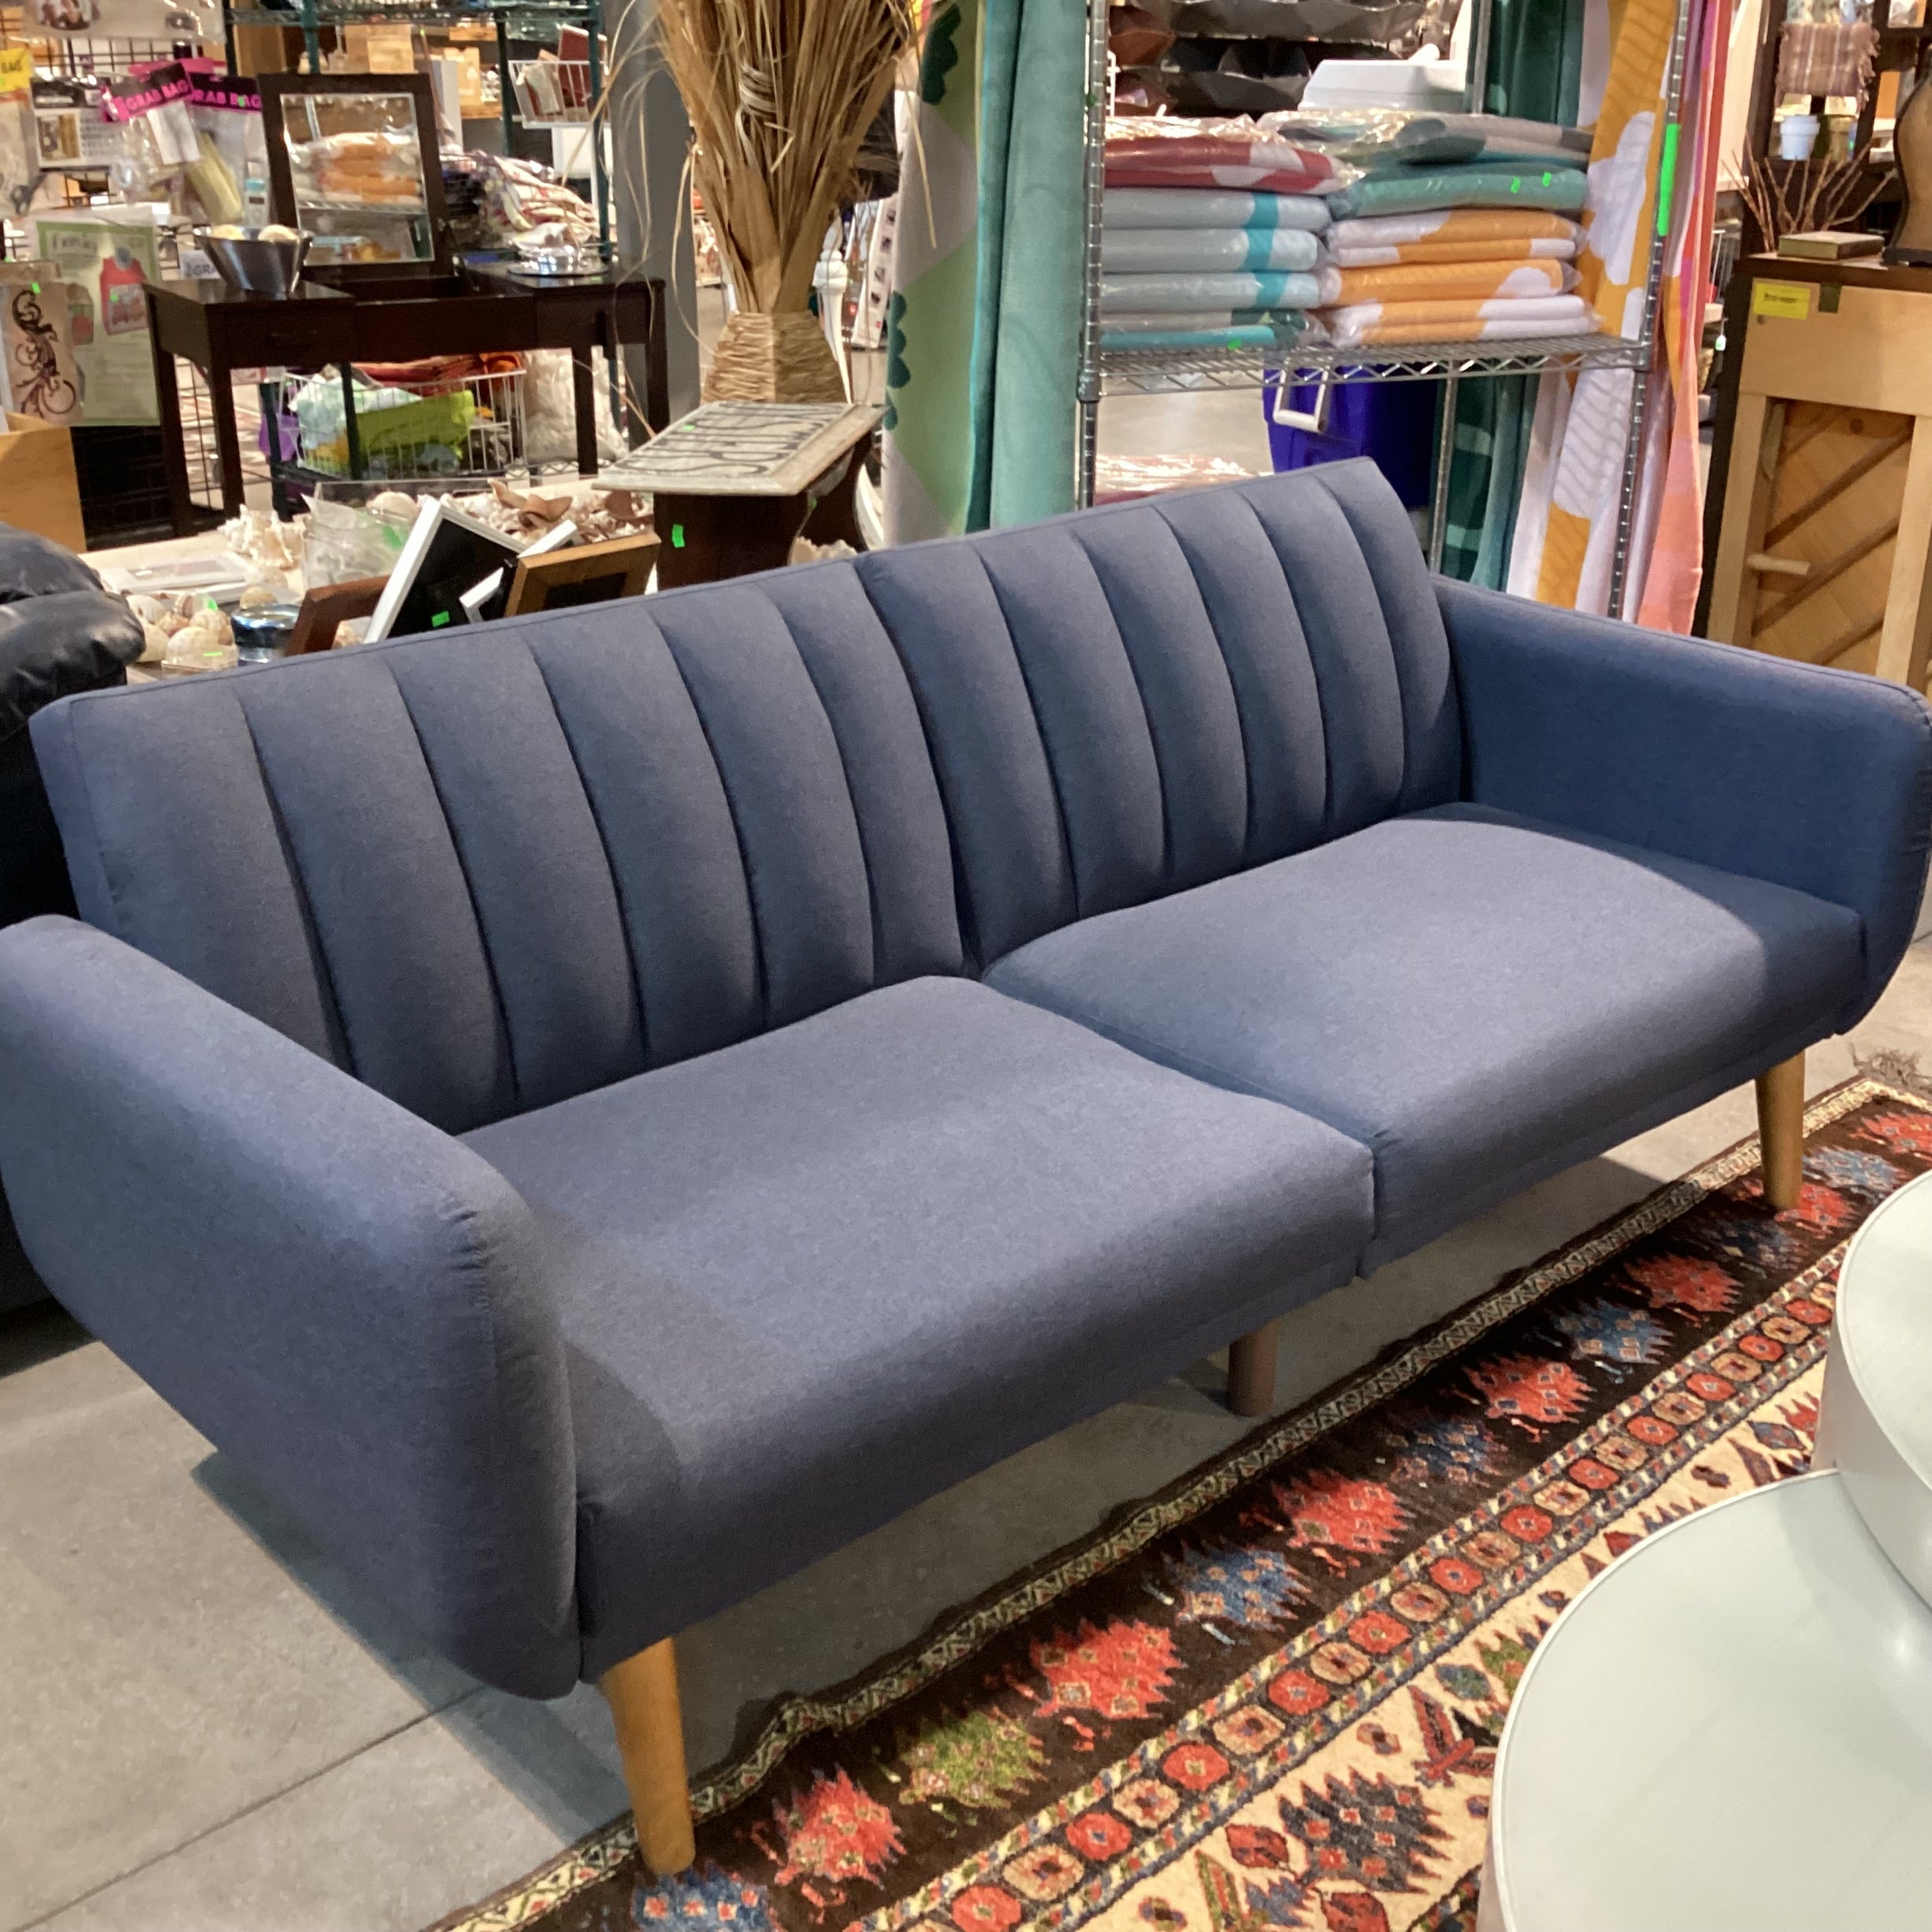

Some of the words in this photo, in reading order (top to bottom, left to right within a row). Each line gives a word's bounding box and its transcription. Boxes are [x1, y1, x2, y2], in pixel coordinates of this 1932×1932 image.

[126, 88, 162, 110] GRAB
[161, 80, 189, 99] BAG
[191, 89, 227, 104] RAB
